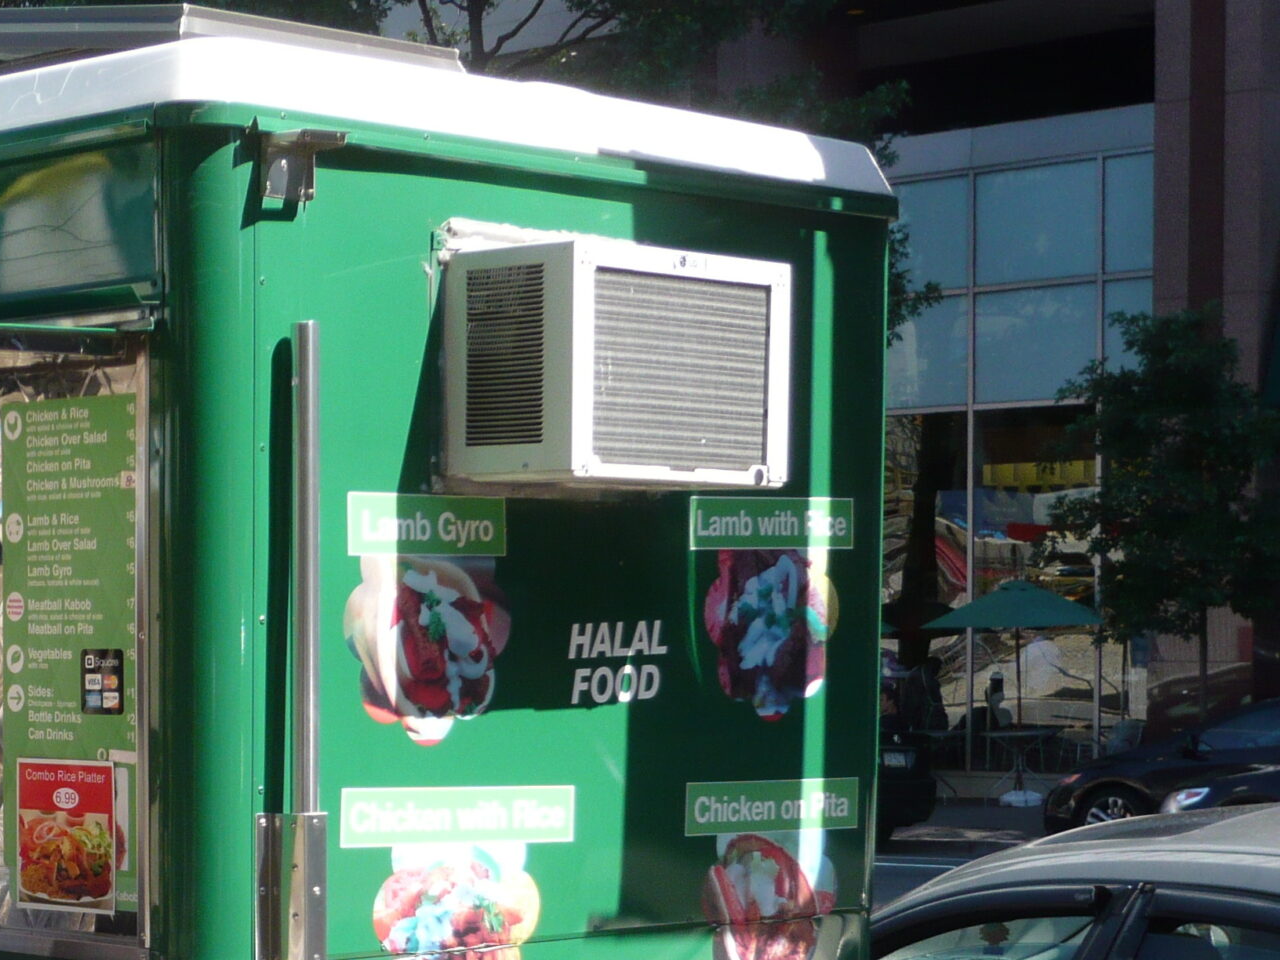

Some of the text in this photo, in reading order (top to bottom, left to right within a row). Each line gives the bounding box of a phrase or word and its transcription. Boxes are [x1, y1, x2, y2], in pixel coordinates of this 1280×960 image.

[26, 410, 58, 422] Chicken
[61, 408, 67, 420] &
[69, 407, 89, 419] Rice
[26, 436, 59, 448] Chicken
[61, 433, 81, 445] Over
[83, 430, 107, 444] Salad
[26, 461, 59, 473] Chicken
[61, 461, 72, 471] on
[74, 458, 91, 470] Pita
[26, 477, 120, 491] Chicken & Mushrooms
[27, 514, 49, 526] Lamb
[52, 513, 58, 525] &
[60, 512, 79, 524] Rice
[696, 508, 847, 537] Lamb with Rice
[361, 508, 494, 548] Lamb Gyro
[27, 540, 49, 552] Lamb
[51, 538, 71, 551] Over
[73, 537, 97, 550] Salad
[27, 564, 50, 577] Lamb
[52, 564, 72, 579] Gyro
[27, 599, 61, 611] Meatball
[64, 598, 92, 611] Kabob
[27, 622, 61, 635] Meatball
[64, 624, 75, 634] on
[77, 622, 94, 634] Pita
[568, 619, 668, 660] HALAL
[28, 647, 72, 662] Vegetables
[27, 685, 54, 697] Sides:
[571, 664, 661, 704] FOOD
[28, 710, 53, 722] Bottle
[54, 710, 82, 724] Drinks
[28, 728, 45, 740] Can
[46, 728, 74, 741] Drinks
[25, 768, 106, 784] Combo Rice Platter
[55, 791, 77, 805] 6.99
[694, 792, 849, 824] Chicken on Pita
[349, 798, 566, 834] Chicken with Rice
